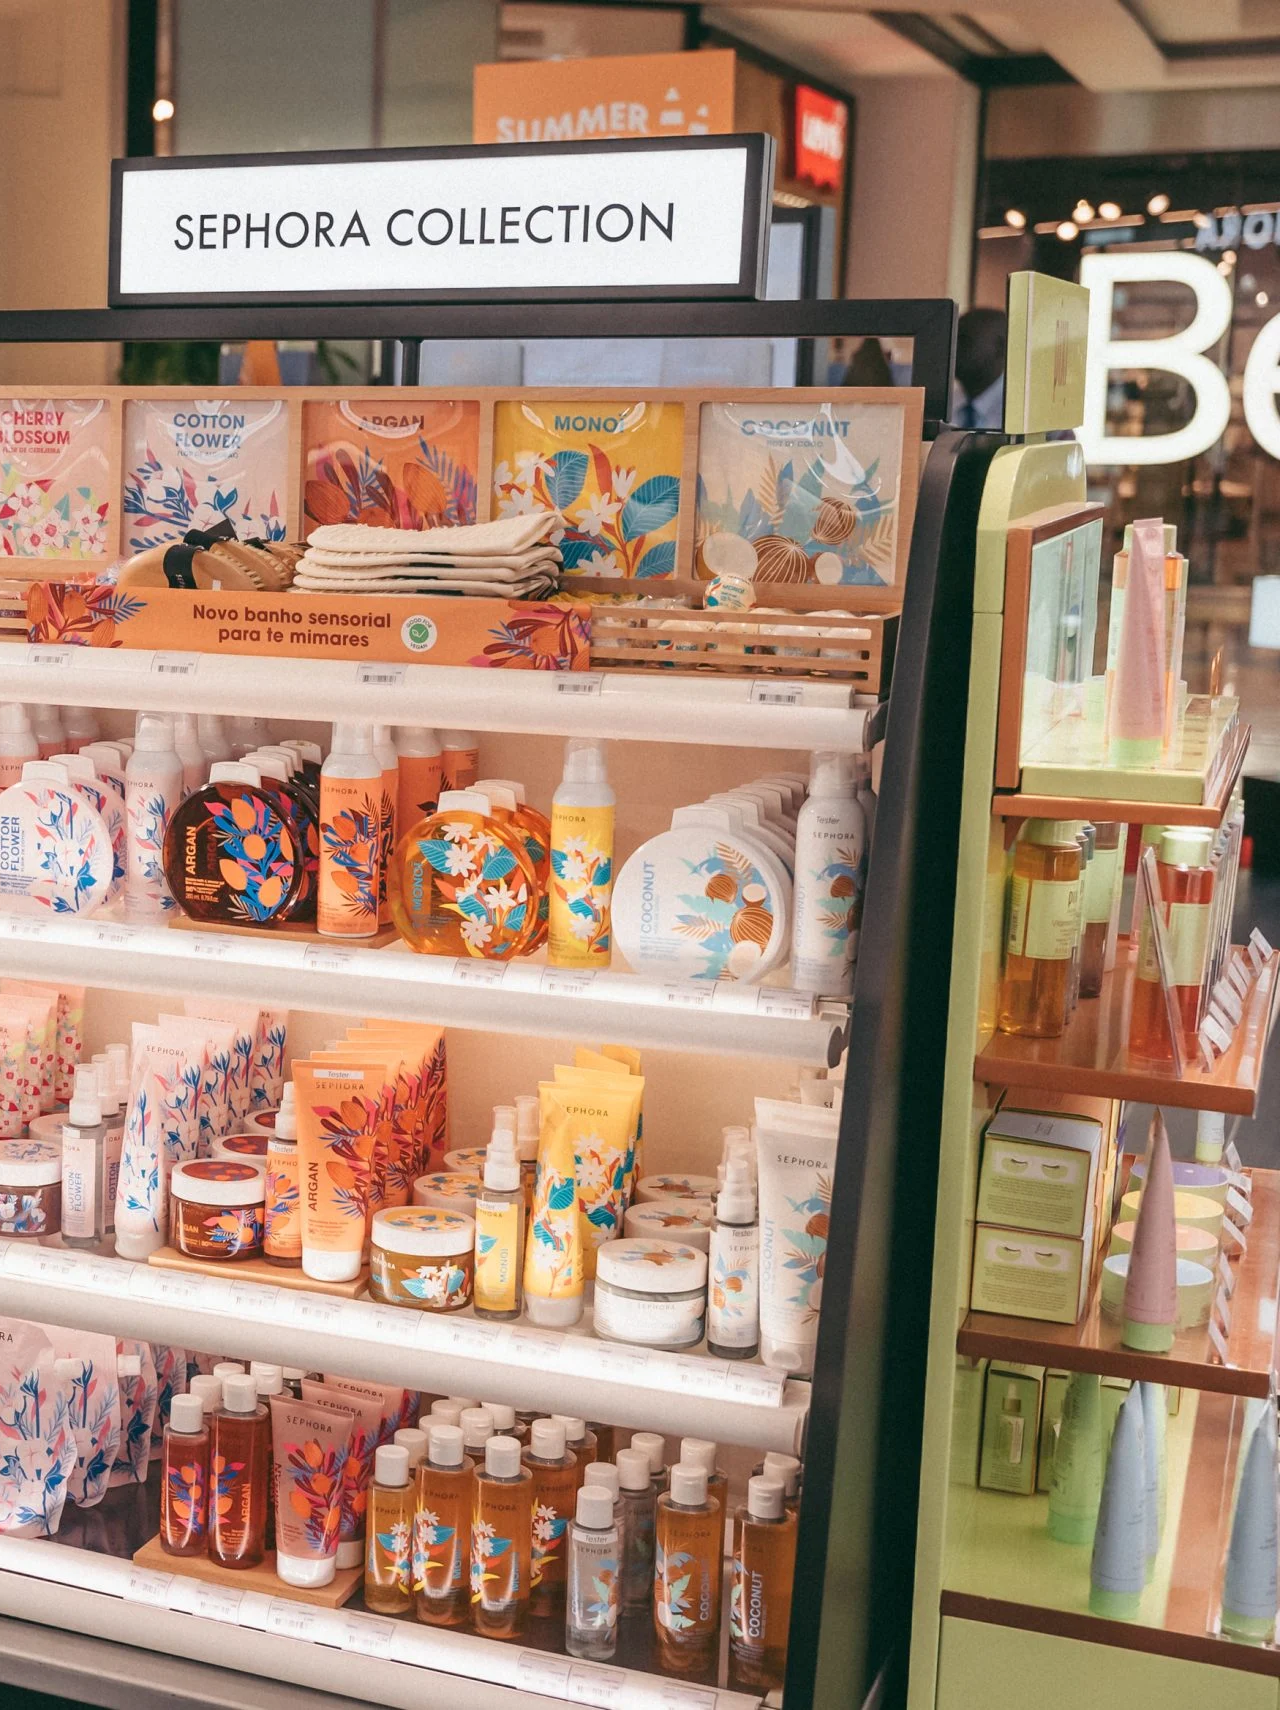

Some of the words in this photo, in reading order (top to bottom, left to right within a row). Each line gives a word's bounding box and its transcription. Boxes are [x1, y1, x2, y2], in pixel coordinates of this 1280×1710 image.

[495, 102, 650, 142] SUMMER
[173, 209, 371, 252] SEPHORA
[385, 202, 677, 247] COLLECTION
[1, 411, 64, 425] CHERRY
[173, 413, 245, 429] COTTON
[358, 415, 425, 430] ARGAN
[740, 420, 851, 437] COCONUT
[175, 433, 241, 449] FLOWER
[193, 604, 239, 621] Novo
[244, 607, 303, 624] banho
[308, 611, 391, 628] sensorial
[406, 617, 422, 628] GOOD
[423, 618, 433, 629] FOR
[218, 627, 261, 643] para
[267, 628, 284, 643] te
[290, 629, 370, 647] mimares
[410, 642, 428, 650] VEGAN
[127, 780, 154, 788] EPHORA
[816, 815, 840, 825] Tester
[0, 816, 10, 870] COTTON
[10, 816, 20, 871] FLOWER
[813, 831, 855, 840] SEPHORA
[185, 826, 196, 875] ARGAN
[641, 861, 655, 933] COCONUT
[146, 1045, 185, 1057] SEPHORA
[328, 1071, 350, 1079] Tester
[316, 1082, 365, 1090] SEPHORA
[566, 1106, 609, 1117] EPHORA
[777, 1154, 829, 1169] SEPHORA
[108, 1162, 116, 1200] COTTON
[308, 1162, 318, 1211] ARGAN
[74, 1172, 82, 1212] FLOWER
[176, 1223, 199, 1233] AGAN
[732, 1229, 753, 1237] Tester
[762, 1218, 775, 1292] COCONUT
[286, 1415, 333, 1434] SEPHORA
[241, 1483, 251, 1524] ARGAN
[585, 1534, 608, 1544] Tester
[699, 1558, 710, 1621] COCONUT
[749, 1571, 763, 1638] COCONUT
